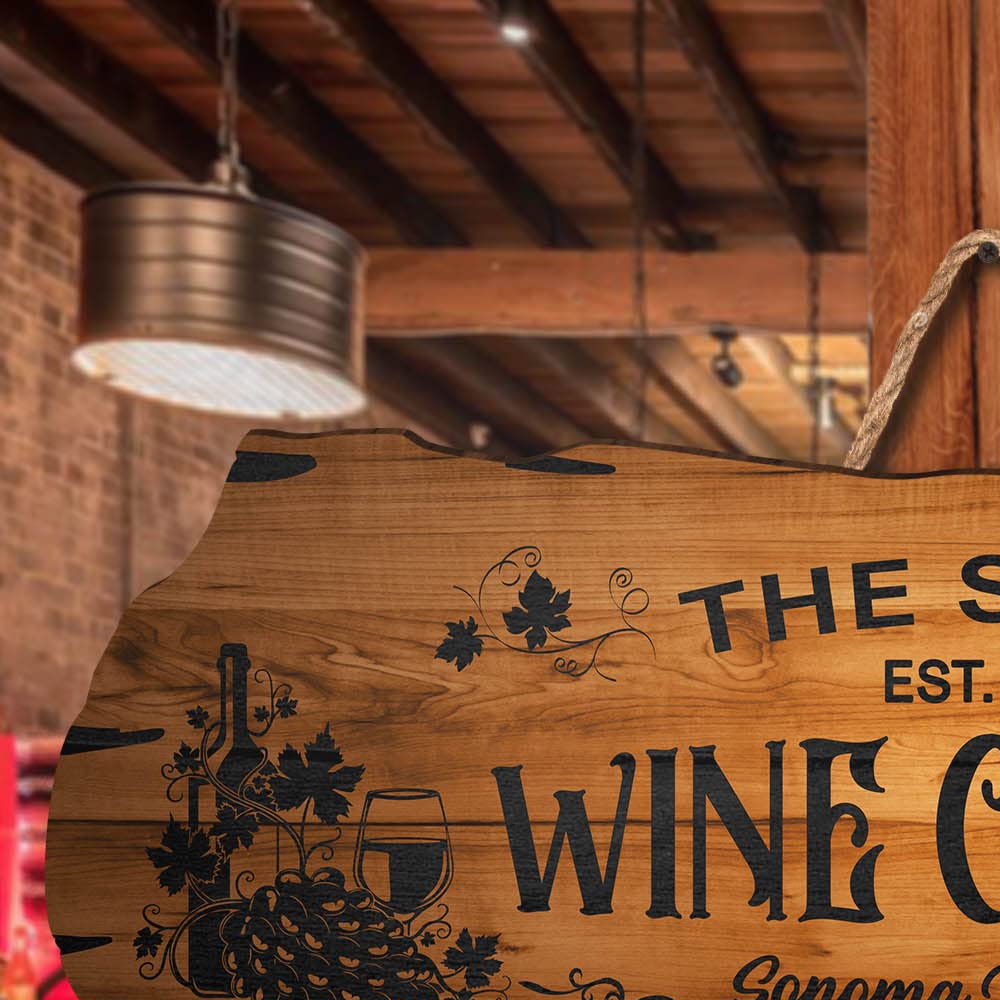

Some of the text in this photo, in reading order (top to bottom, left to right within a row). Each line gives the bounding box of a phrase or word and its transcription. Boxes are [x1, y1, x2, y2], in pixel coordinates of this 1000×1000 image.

[678, 558, 914, 653] THE
[884, 659, 993, 703] EST.
[491, 737, 887, 922] WINE
